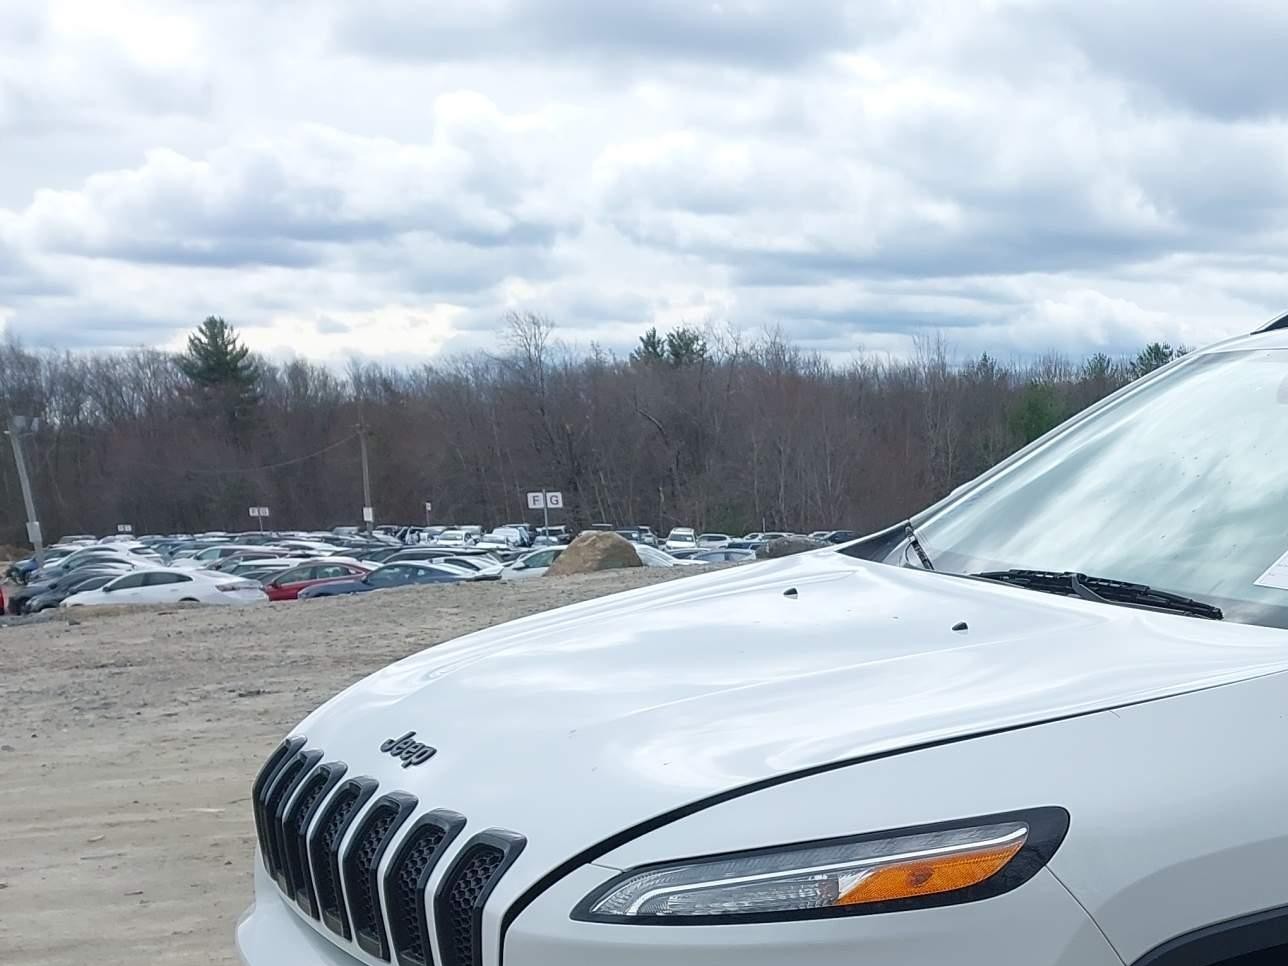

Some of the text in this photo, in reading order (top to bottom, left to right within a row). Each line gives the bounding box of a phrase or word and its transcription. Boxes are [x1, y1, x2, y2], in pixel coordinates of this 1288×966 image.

[532, 495, 540, 506] F
[549, 494, 559, 506] G
[380, 731, 437, 768] Jeep
